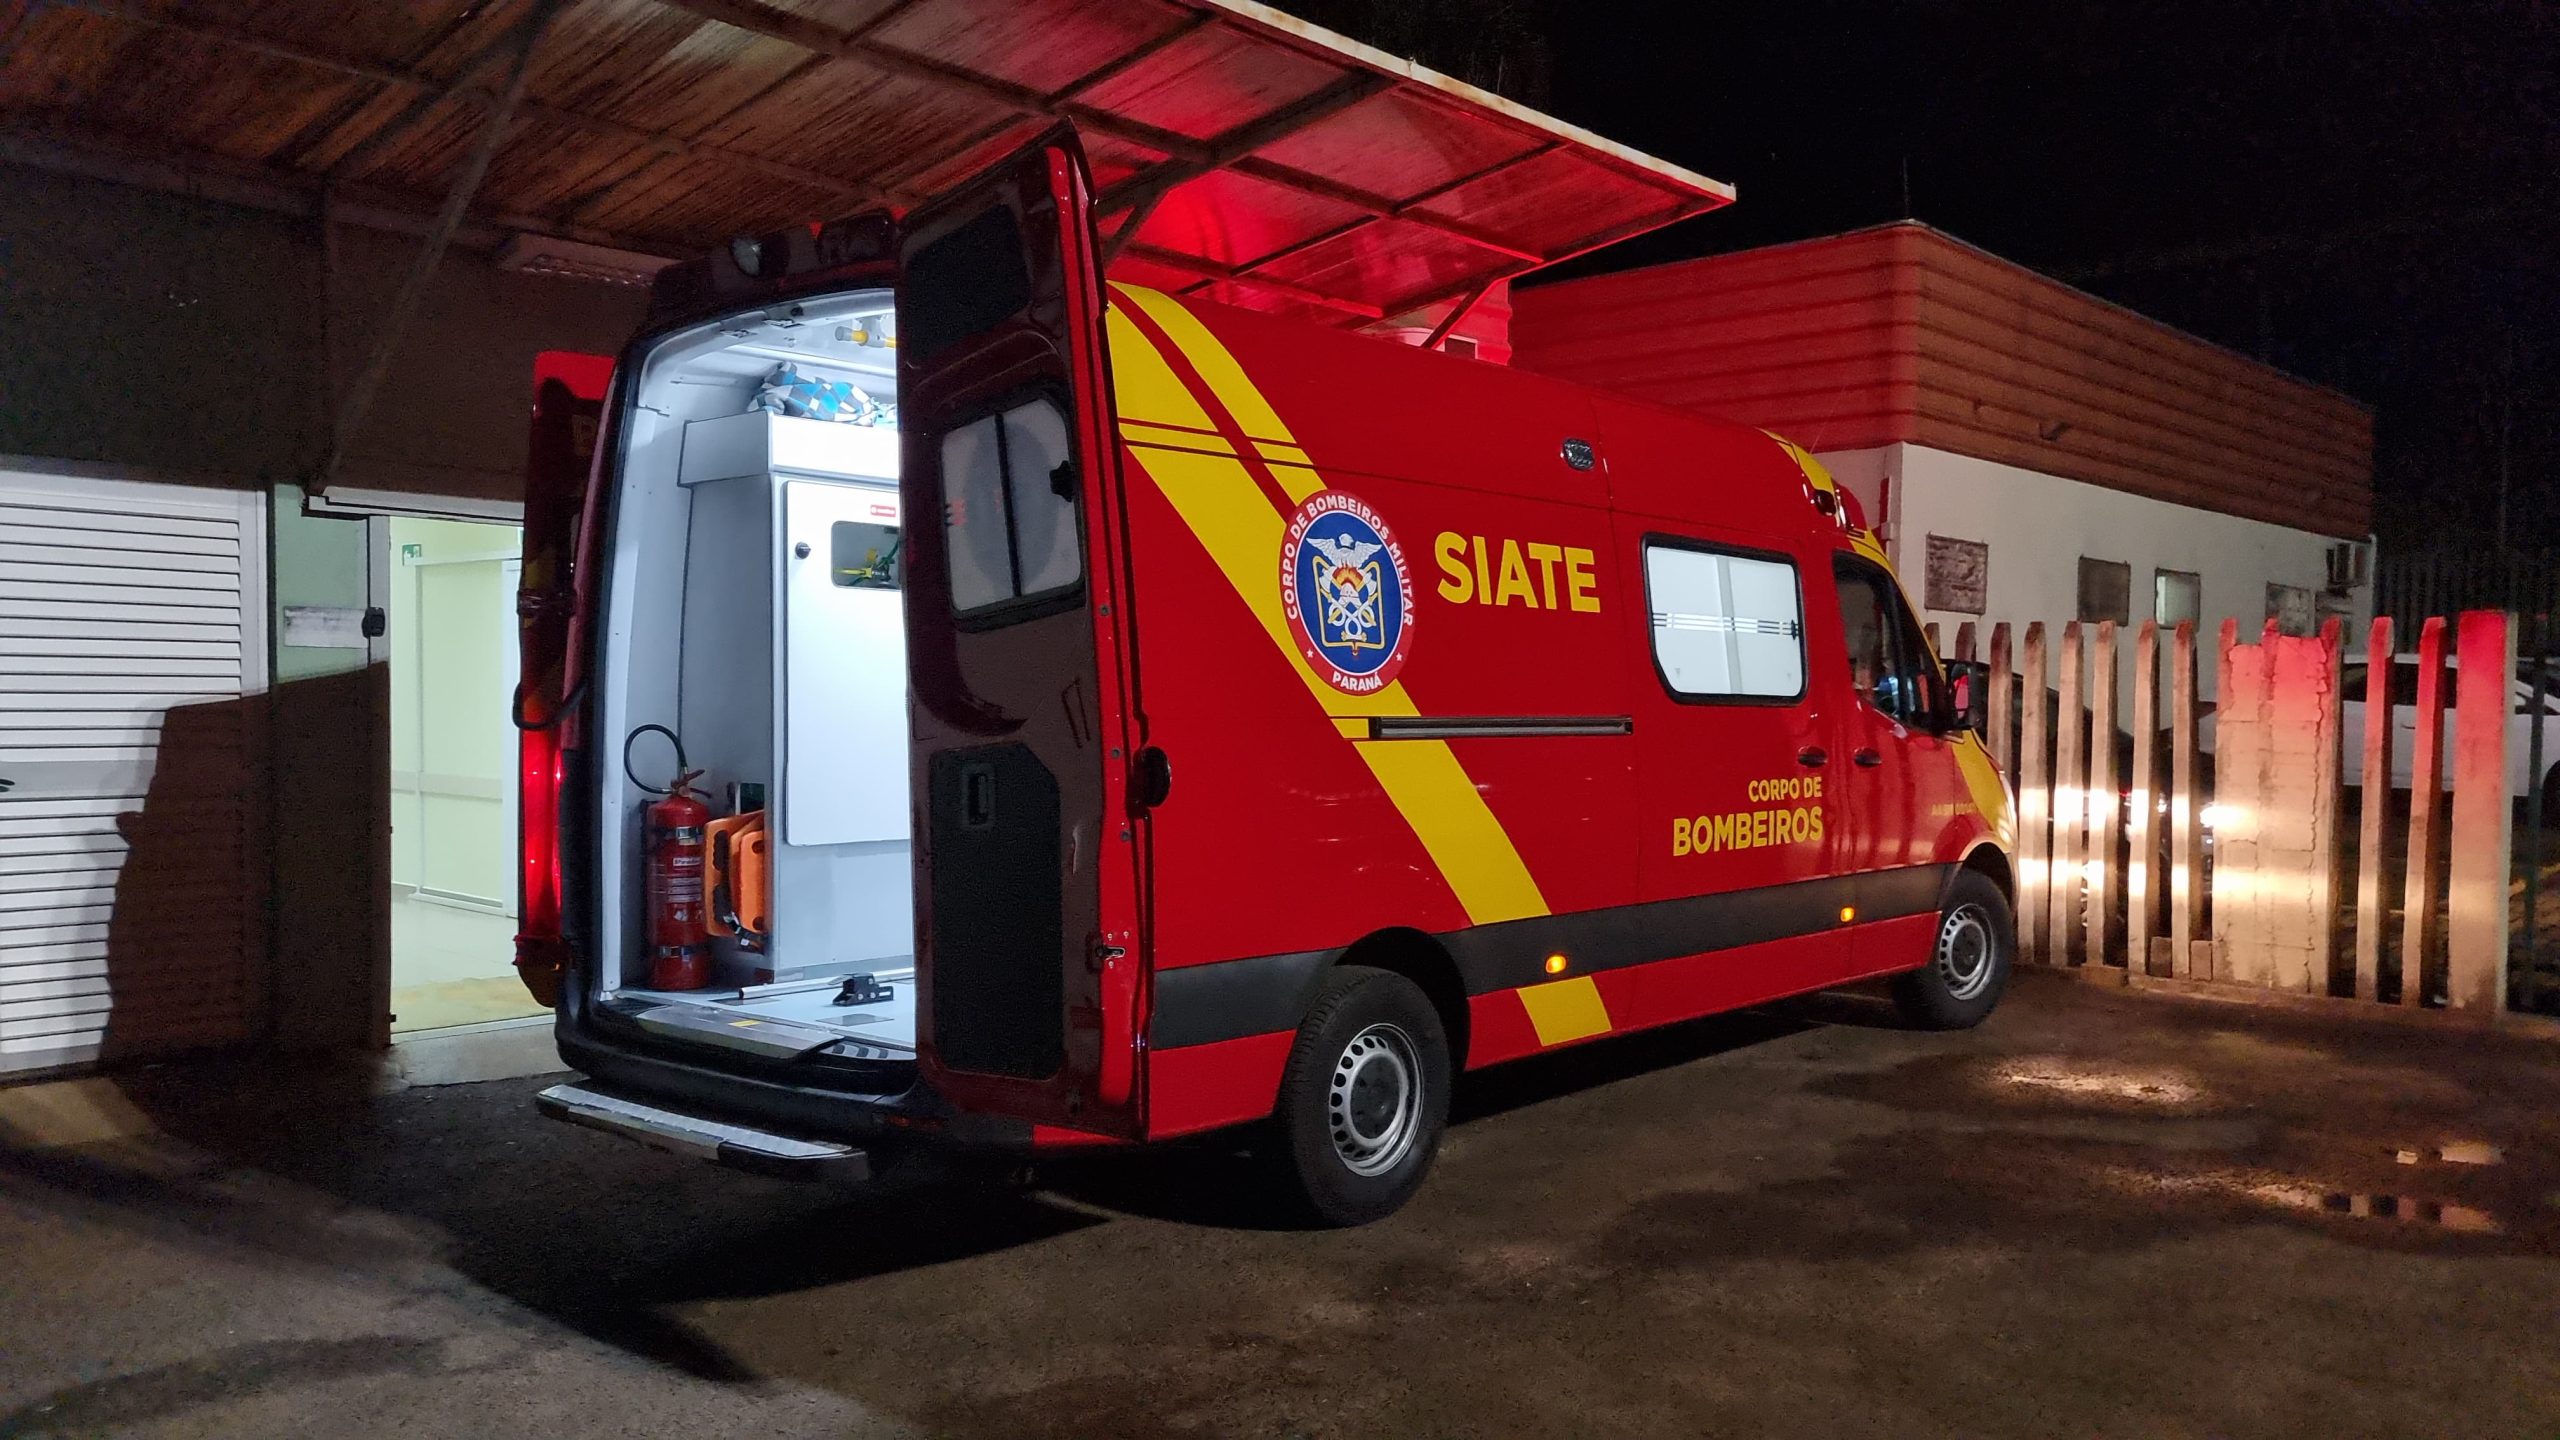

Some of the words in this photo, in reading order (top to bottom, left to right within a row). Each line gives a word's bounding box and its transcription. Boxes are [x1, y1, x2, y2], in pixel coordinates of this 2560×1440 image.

[1282, 543, 1298, 620] CORPO
[1290, 512, 1308, 540] DE
[1306, 495, 1390, 540] BOMBEIROS
[1389, 542, 1413, 627] MILITAR
[1434, 531, 1601, 613] SIATE
[1332, 671, 1383, 692] PARANÁ
[1748, 777, 1800, 803] CORPO
[1803, 776, 1823, 799] DE
[1673, 805, 1824, 857] BOMBEIROS
